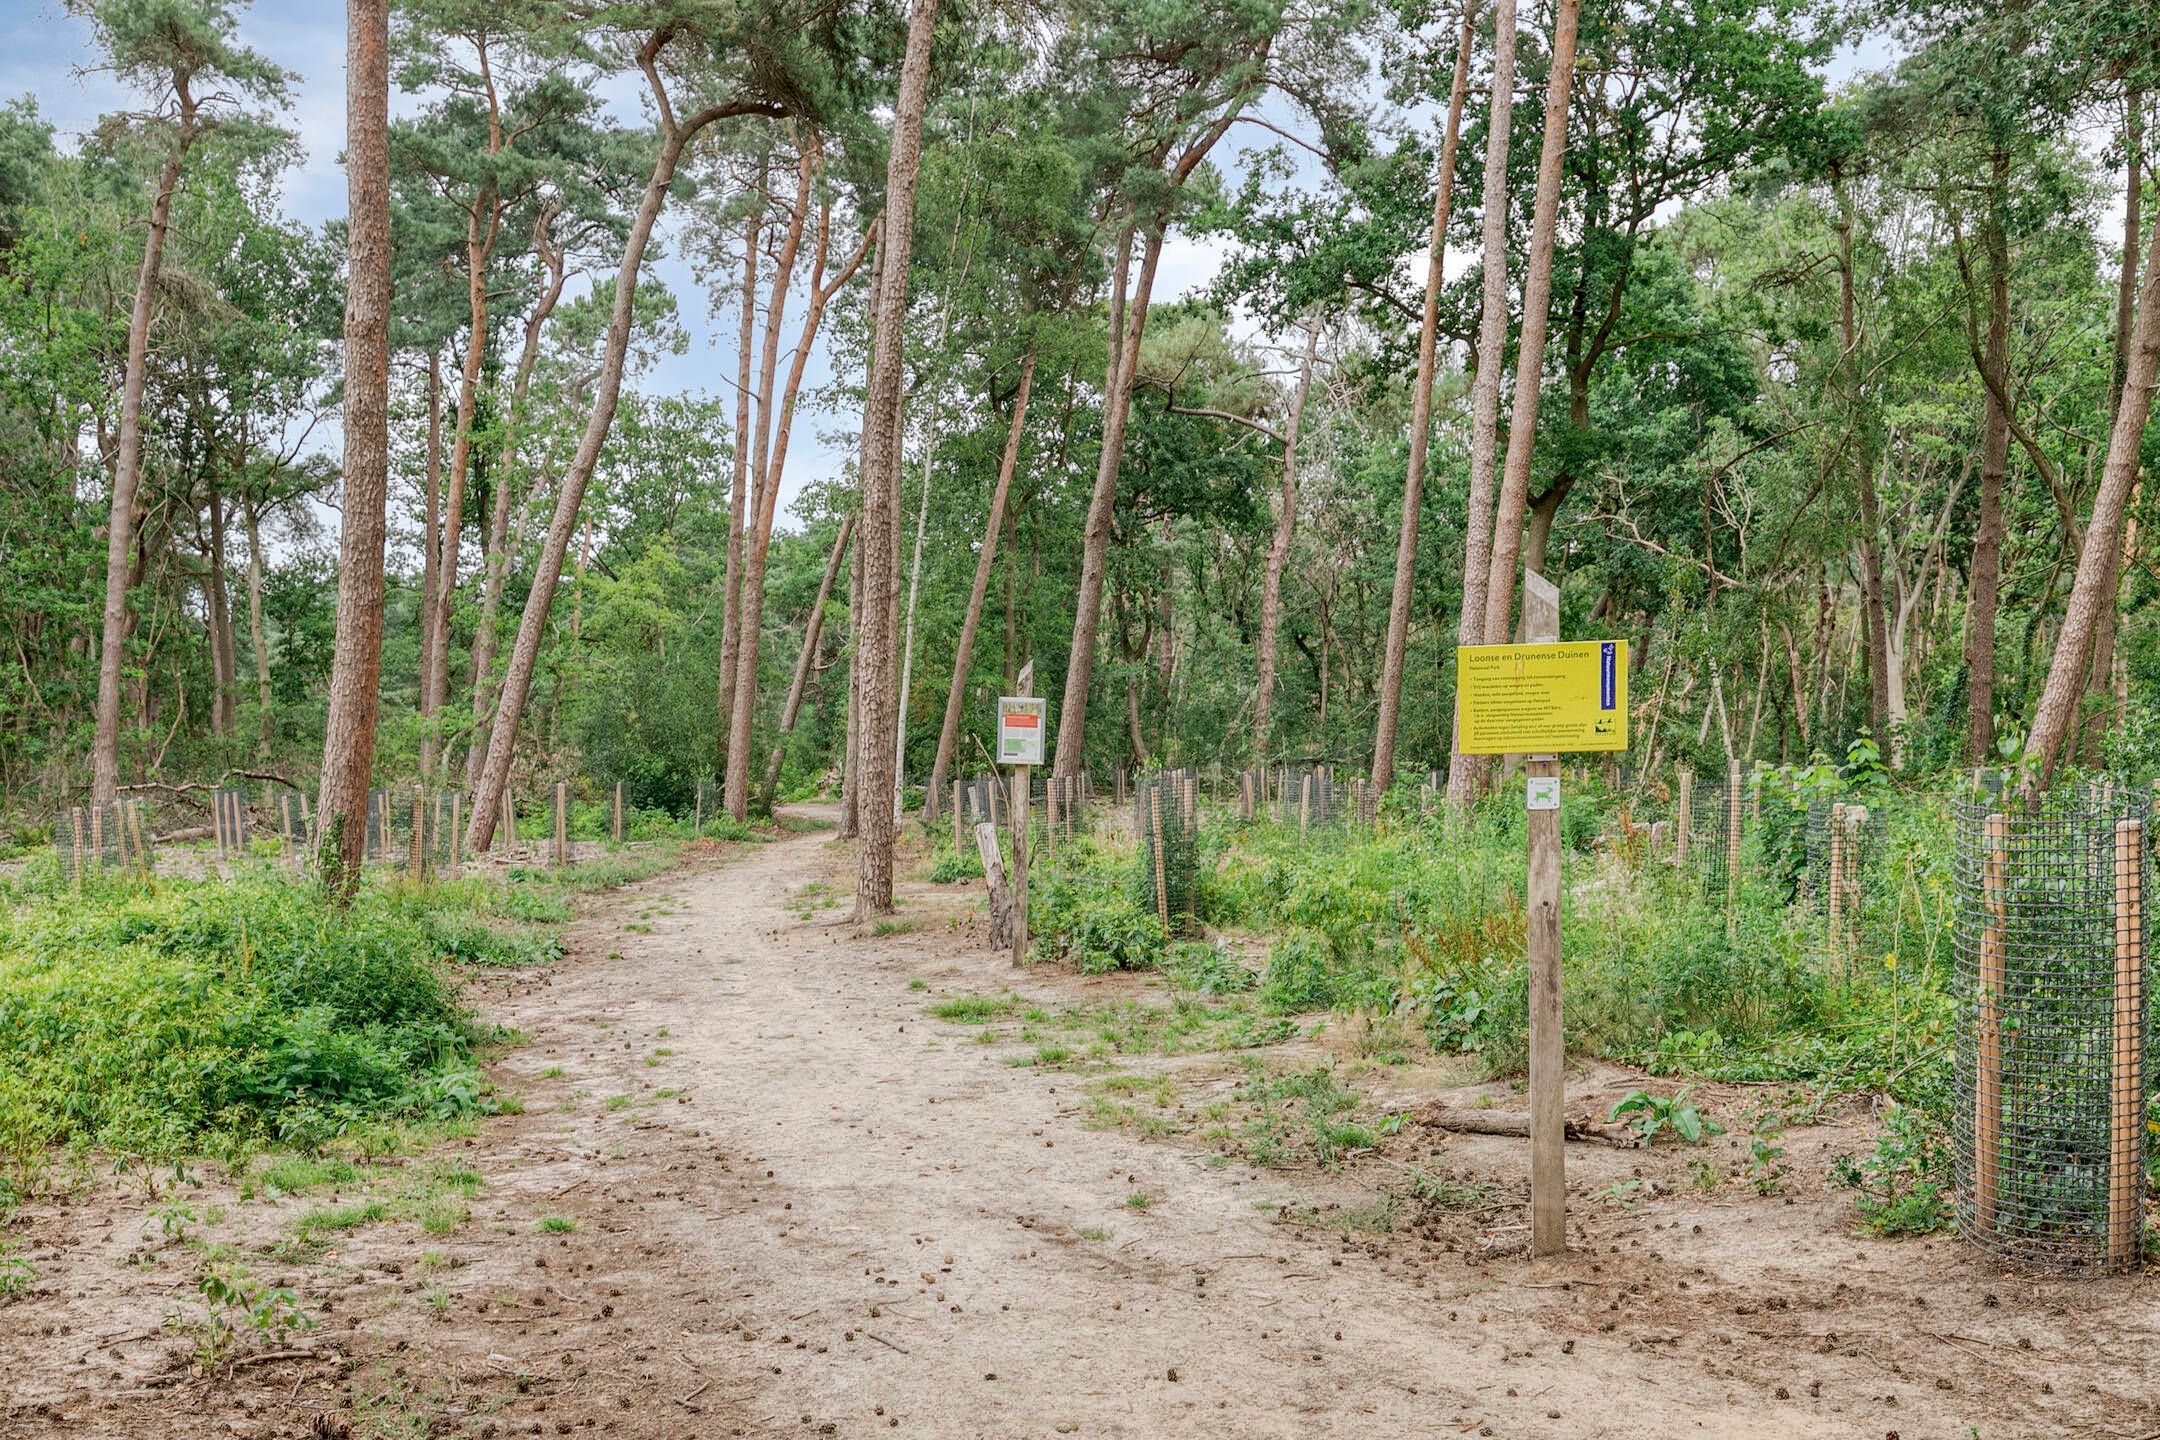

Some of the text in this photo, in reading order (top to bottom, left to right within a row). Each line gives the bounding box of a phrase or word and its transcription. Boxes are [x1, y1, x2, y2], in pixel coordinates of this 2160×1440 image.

[1469, 654, 1500, 662] Loonse
[1514, 652, 1556, 660] Drunense
[1558, 651, 1590, 659] Duinen
